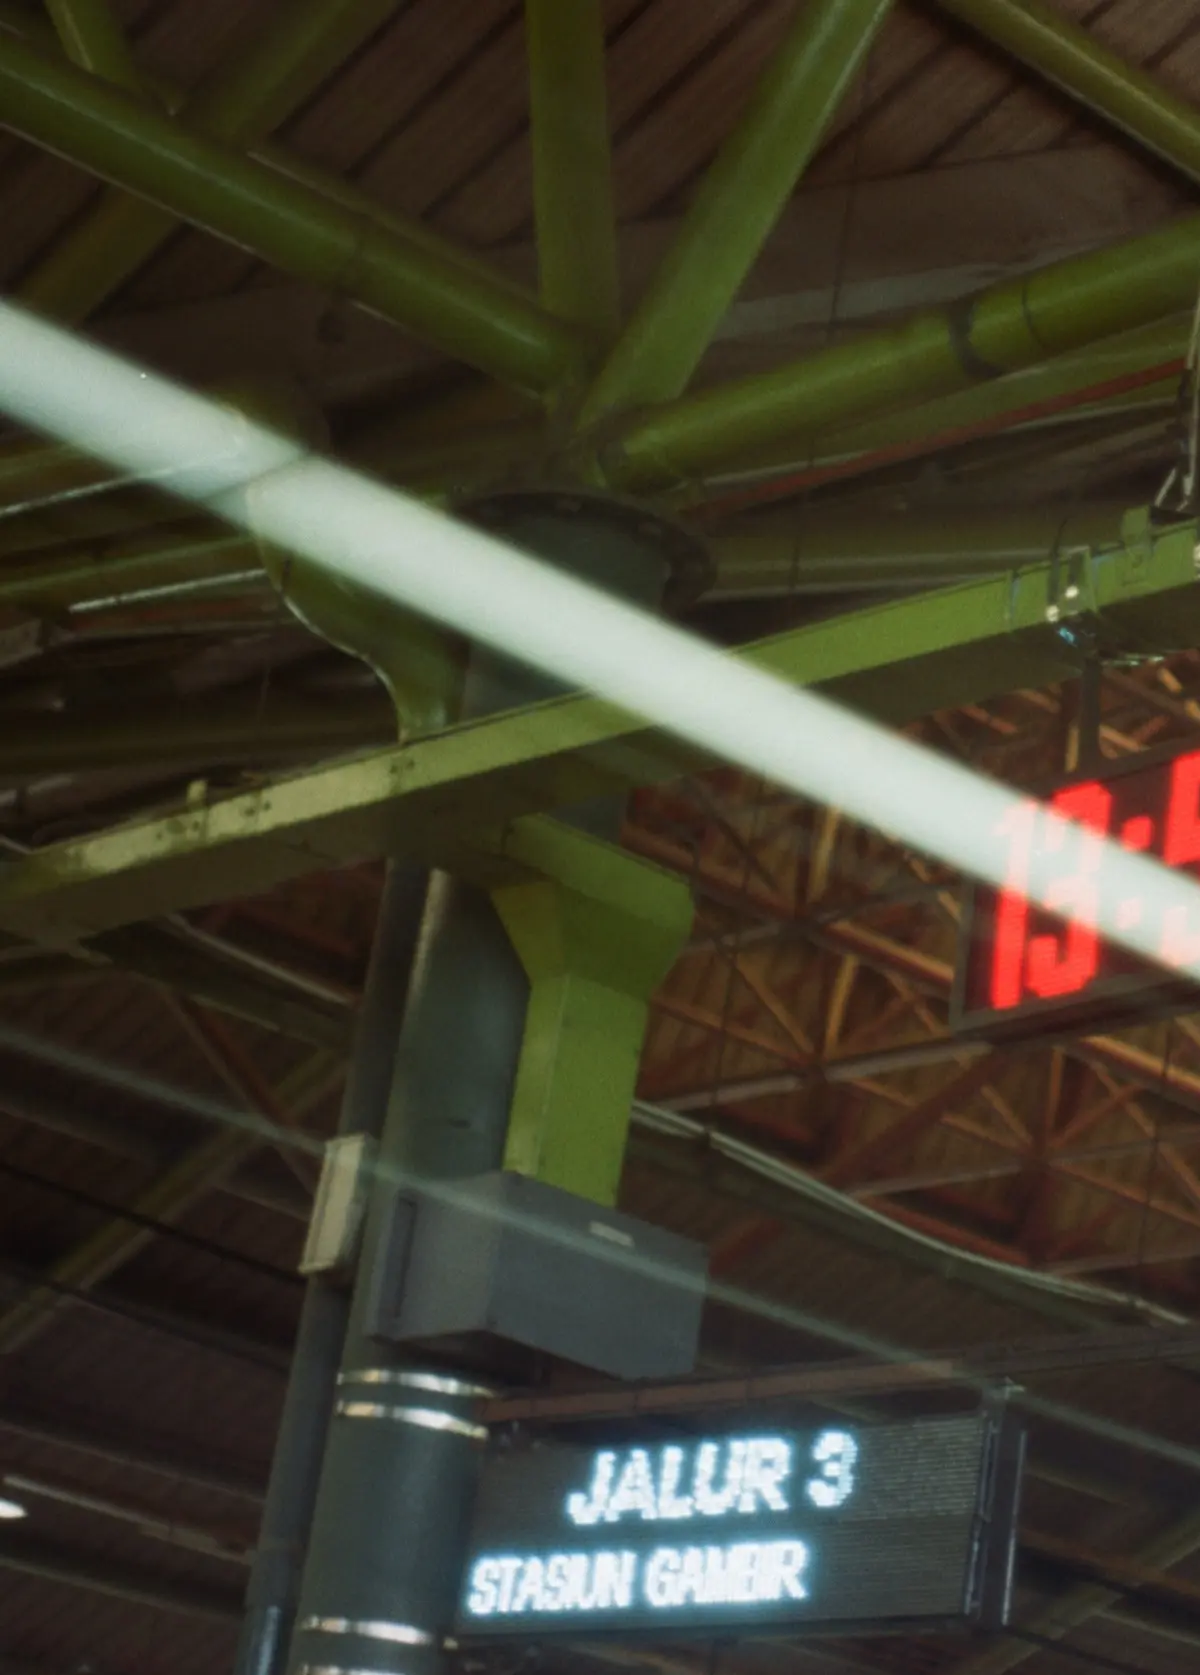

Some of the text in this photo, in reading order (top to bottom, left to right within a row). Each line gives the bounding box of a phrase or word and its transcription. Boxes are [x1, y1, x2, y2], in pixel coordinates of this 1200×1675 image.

[566, 1430, 859, 1526] JALUR 3
[466, 1538, 811, 1616] STASIUN GAMBIR
